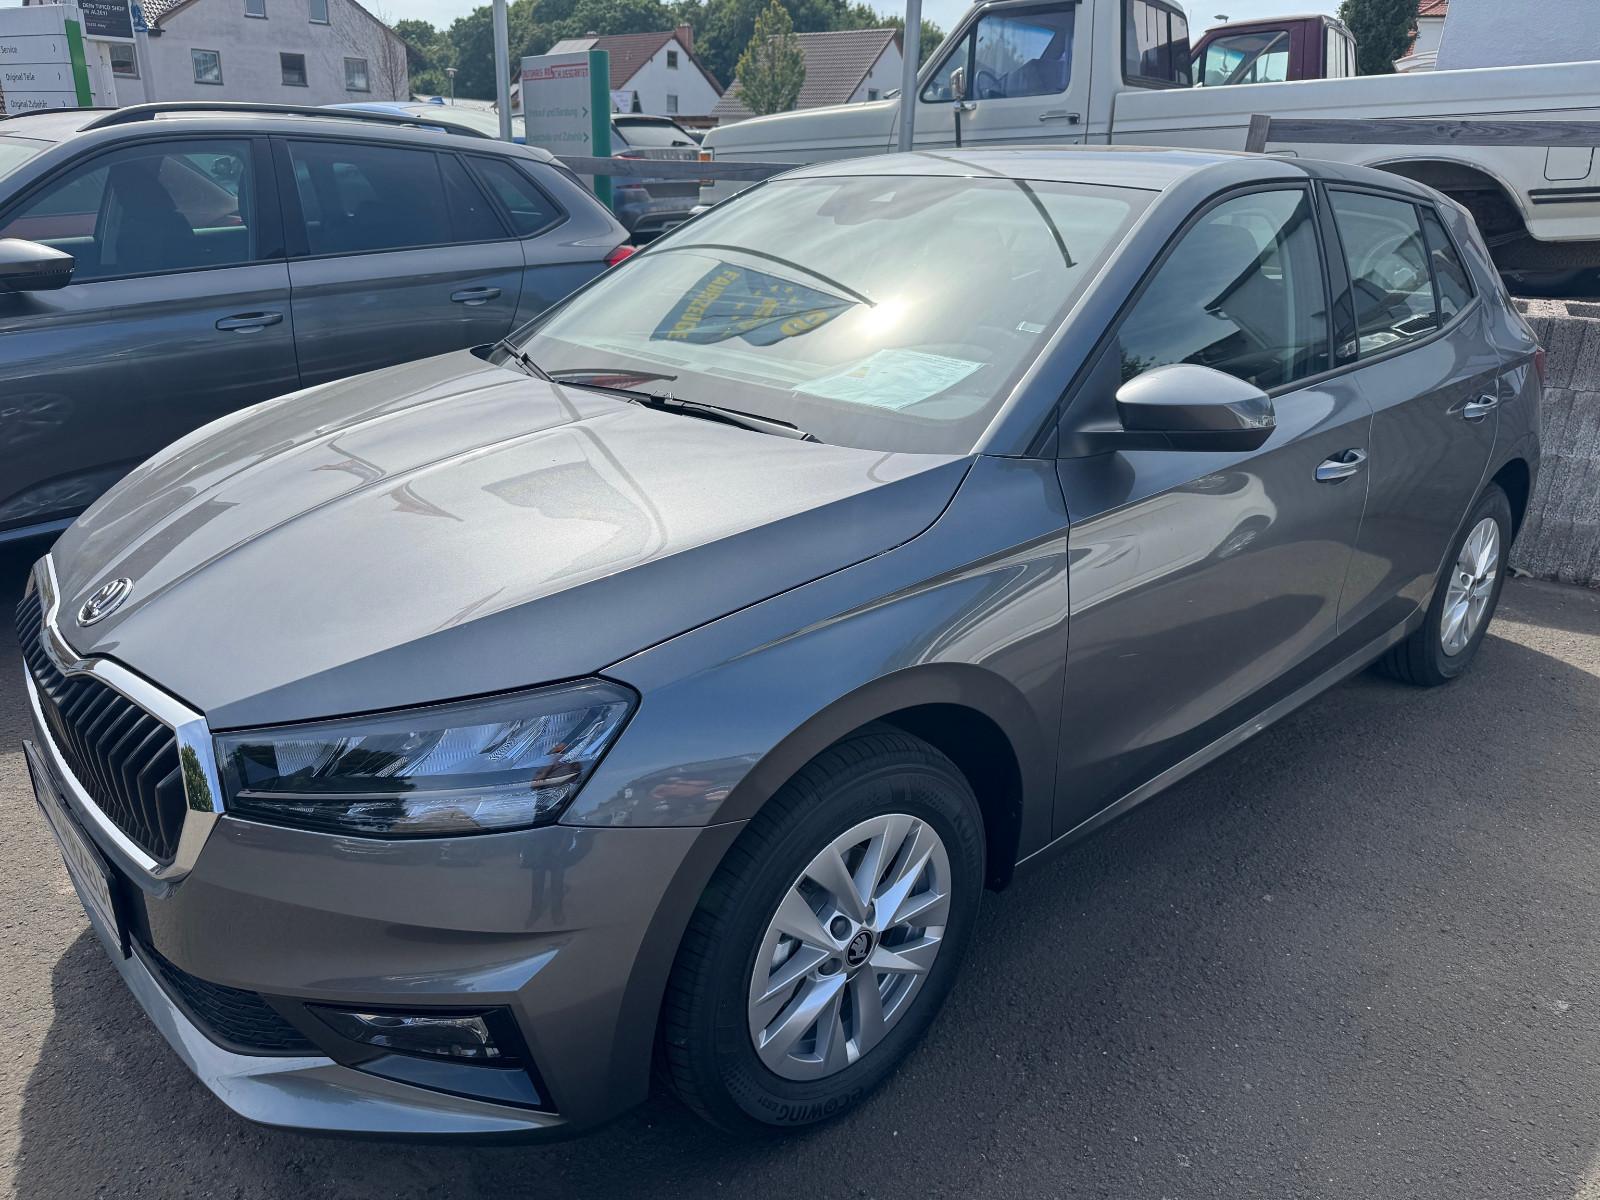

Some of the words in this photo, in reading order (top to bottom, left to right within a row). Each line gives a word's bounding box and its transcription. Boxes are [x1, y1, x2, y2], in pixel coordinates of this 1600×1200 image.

[0, 45, 18, 54] Service
[5, 72, 23, 82] Original
[10, 99, 28, 109] Original
